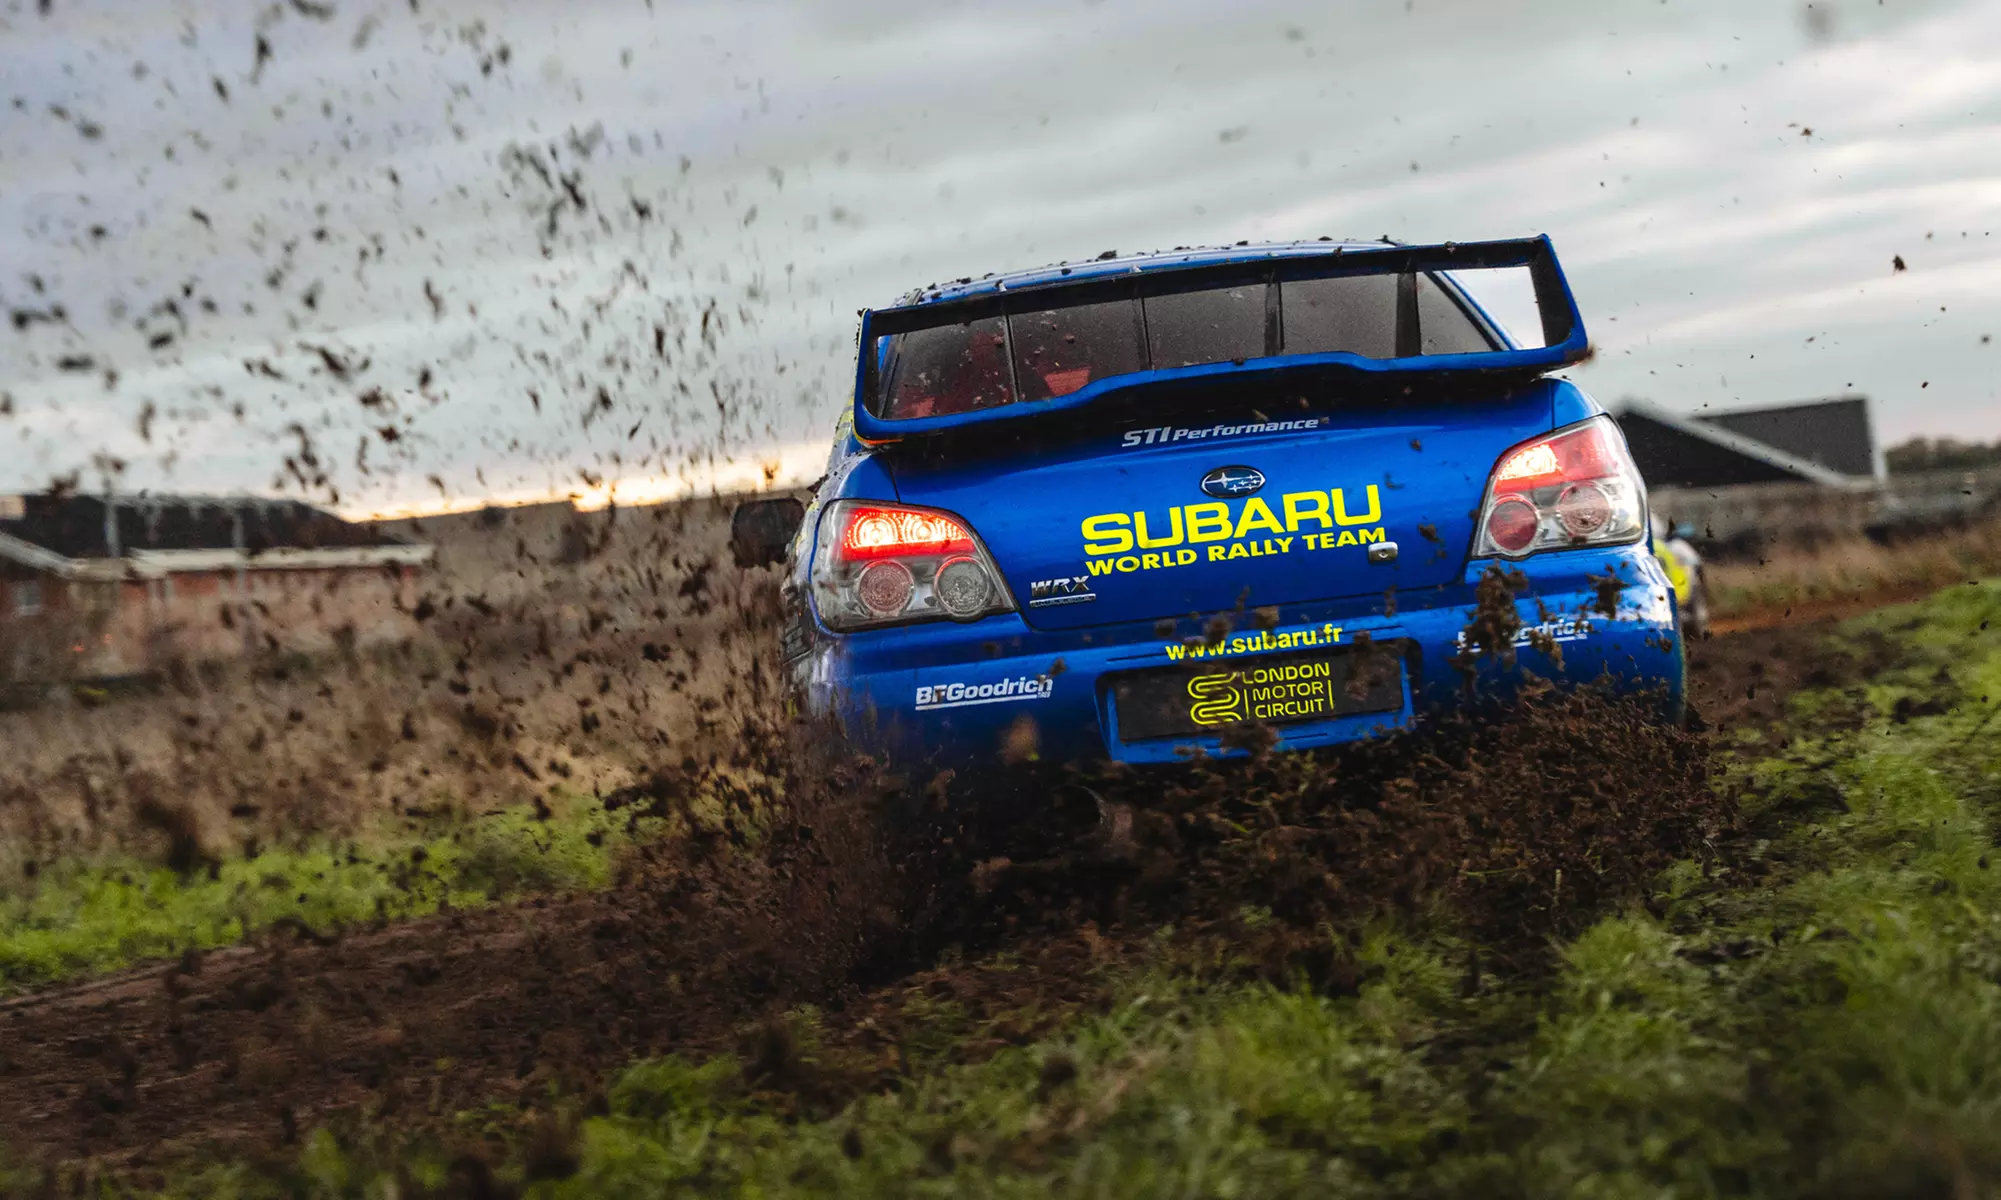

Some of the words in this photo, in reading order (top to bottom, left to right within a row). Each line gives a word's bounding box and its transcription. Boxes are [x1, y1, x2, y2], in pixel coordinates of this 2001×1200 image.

[1122, 426, 1171, 447] STI
[1173, 419, 1319, 440] Performance
[1081, 484, 1382, 556] SUBARU
[1085, 550, 1197, 577] WORLD
[1208, 537, 1294, 562] RALLY
[1302, 527, 1386, 549] TEAM
[1030, 575, 1090, 596] WRX
[1165, 624, 1343, 661] www.subaru.fr
[1242, 662, 1331, 684] LONDON
[916, 676, 1054, 705] BFGoodrich
[1252, 682, 1324, 701] MOTOR
[1254, 698, 1325, 718] CIRCUIT
